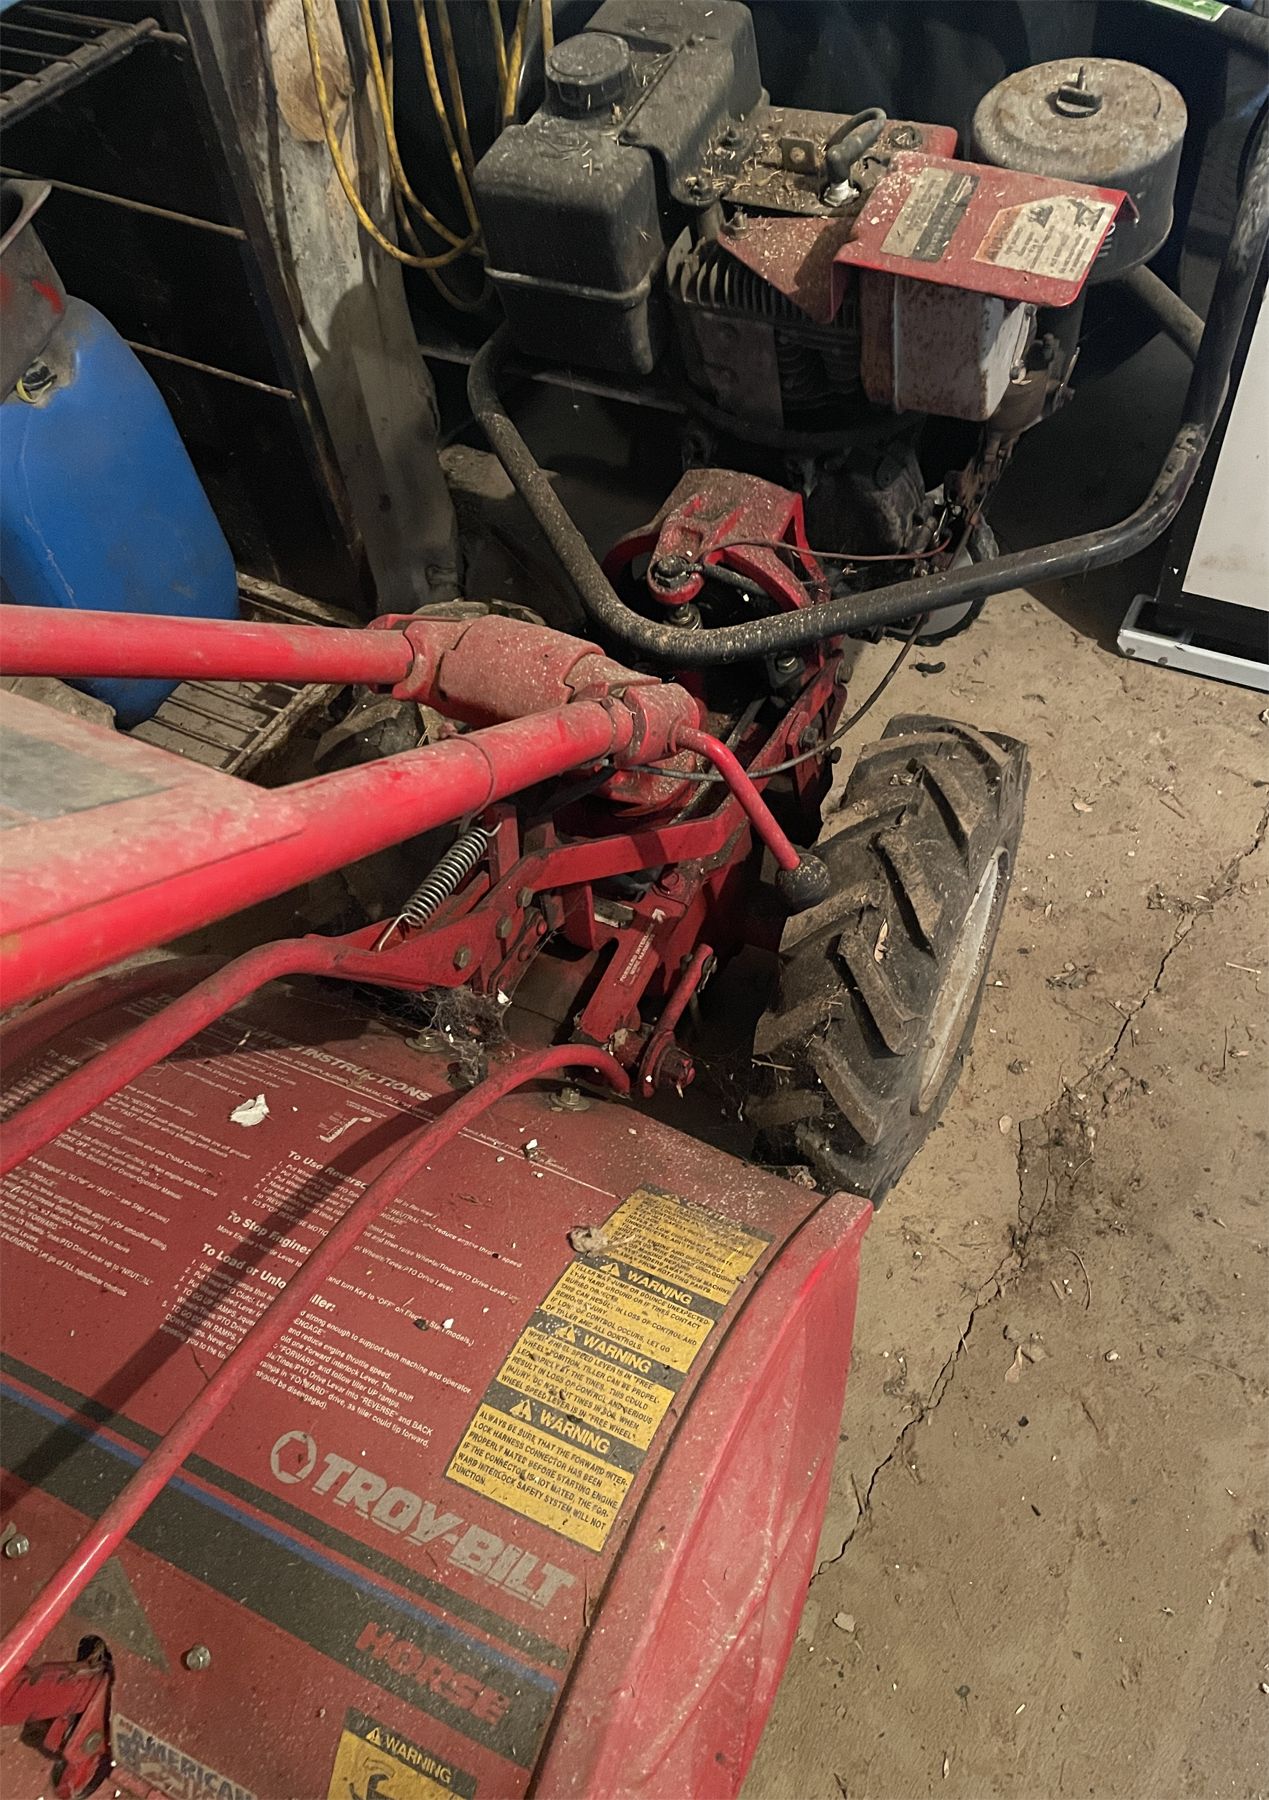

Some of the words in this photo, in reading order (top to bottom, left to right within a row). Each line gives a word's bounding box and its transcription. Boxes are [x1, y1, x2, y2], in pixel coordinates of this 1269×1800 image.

[301, 1156, 325, 1171] Use
[215, 1249, 247, 1270] Load
[238, 1217, 270, 1238] Stop
[266, 1229, 314, 1257] Engine:
[275, 1251, 296, 1264] Lever
[586, 1276, 605, 1288] HARD
[669, 1312, 701, 1330] CONTACT
[610, 1278, 629, 1290] JUMP
[638, 1291, 667, 1307] BOUNCE
[624, 1269, 694, 1306] WARNING
[574, 1288, 590, 1299] CAN
[622, 1309, 641, 1321] LOSS
[650, 1321, 682, 1339] CONTROL
[681, 1335, 698, 1346] AND
[591, 1324, 606, 1334] ALL
[615, 1324, 647, 1343] OCCURS,
[645, 1337, 660, 1348] LET
[290, 1338, 305, 1350] one
[379, 1381, 399, 1395] Then
[299, 1331, 324, 1348] reduce
[321, 1342, 346, 1359] engine
[344, 1353, 370, 1370] throttle
[367, 1363, 393, 1381] speed.
[304, 1311, 327, 1328] strong
[324, 1321, 352, 1339] enough
[356, 1335, 385, 1354] support
[383, 1347, 401, 1361] both
[398, 1355, 429, 1374] machine
[427, 1368, 443, 1381] and
[570, 1348, 594, 1363] SPEED
[593, 1358, 617, 1373] LEVER
[631, 1375, 653, 1390] "FREE
[580, 1333, 653, 1374] WARNING
[307, 1370, 328, 1385] Drive
[396, 1413, 413, 1426] and
[410, 1420, 434, 1436] BACK
[316, 1362, 332, 1375] and
[375, 1391, 402, 1410] ramps.
[499, 1373, 525, 1390] WHEEL
[523, 1384, 548, 1400] SPEED
[546, 1394, 571, 1411] LEVER
[586, 1412, 609, 1428] "FREE
[510, 1355, 538, 1372] RESULT
[545, 1370, 565, 1384] LOSS
[574, 1383, 607, 1403] CONTROL
[607, 1398, 623, 1411] AND
[569, 1370, 584, 1382] THE
[608, 1387, 625, 1400] THIS
[623, 1394, 649, 1411] COULD
[581, 1364, 606, 1380] TILLER
[605, 1374, 621, 1387] CAN
[630, 1386, 661, 1405] PROPEL-
[370, 1413, 393, 1429] could
[536, 1408, 612, 1455] WARNING
[572, 1394, 594, 1409] TINES
[617, 1415, 640, 1430] WHEN
[467, 1430, 504, 1454] PROPERLY
[502, 1447, 528, 1465] MATED
[527, 1459, 557, 1479] BEFORE
[555, 1472, 592, 1496] STARTING
[590, 1489, 621, 1510] ENGINE.
[472, 1420, 493, 1435] LOCK
[491, 1429, 525, 1450] HARNESS
[523, 1444, 568, 1471] CONNECTOR
[566, 1464, 583, 1478] HAS
[582, 1472, 603, 1488] BEEN
[478, 1409, 508, 1429] ALWAYS
[516, 1427, 537, 1443] SURE
[536, 1437, 555, 1452] THAT
[555, 1446, 571, 1459] THE
[569, 1453, 606, 1476] FORWARD
[604, 1469, 629, 1487] INTER-
[451, 1462, 488, 1486] FUNCTION.
[456, 1451, 478, 1468] WARD
[476, 1461, 516, 1486] INTERLOCK
[515, 1480, 544, 1500] SAFETY
[542, 1493, 573, 1514] SYSTEM
[571, 1507, 591, 1523] WILL
[589, 1516, 606, 1531] NOT
[470, 1445, 485, 1457] THE
[483, 1451, 528, 1478] CONNECTOR
[549, 1483, 577, 1502] MATED,
[576, 1496, 592, 1510] THE
[590, 1502, 610, 1519] FOR-
[311, 1451, 578, 1610] TROY-BILT
[355, 1622, 510, 1726] HORSE
[386, 1733, 452, 1784] WARNING
